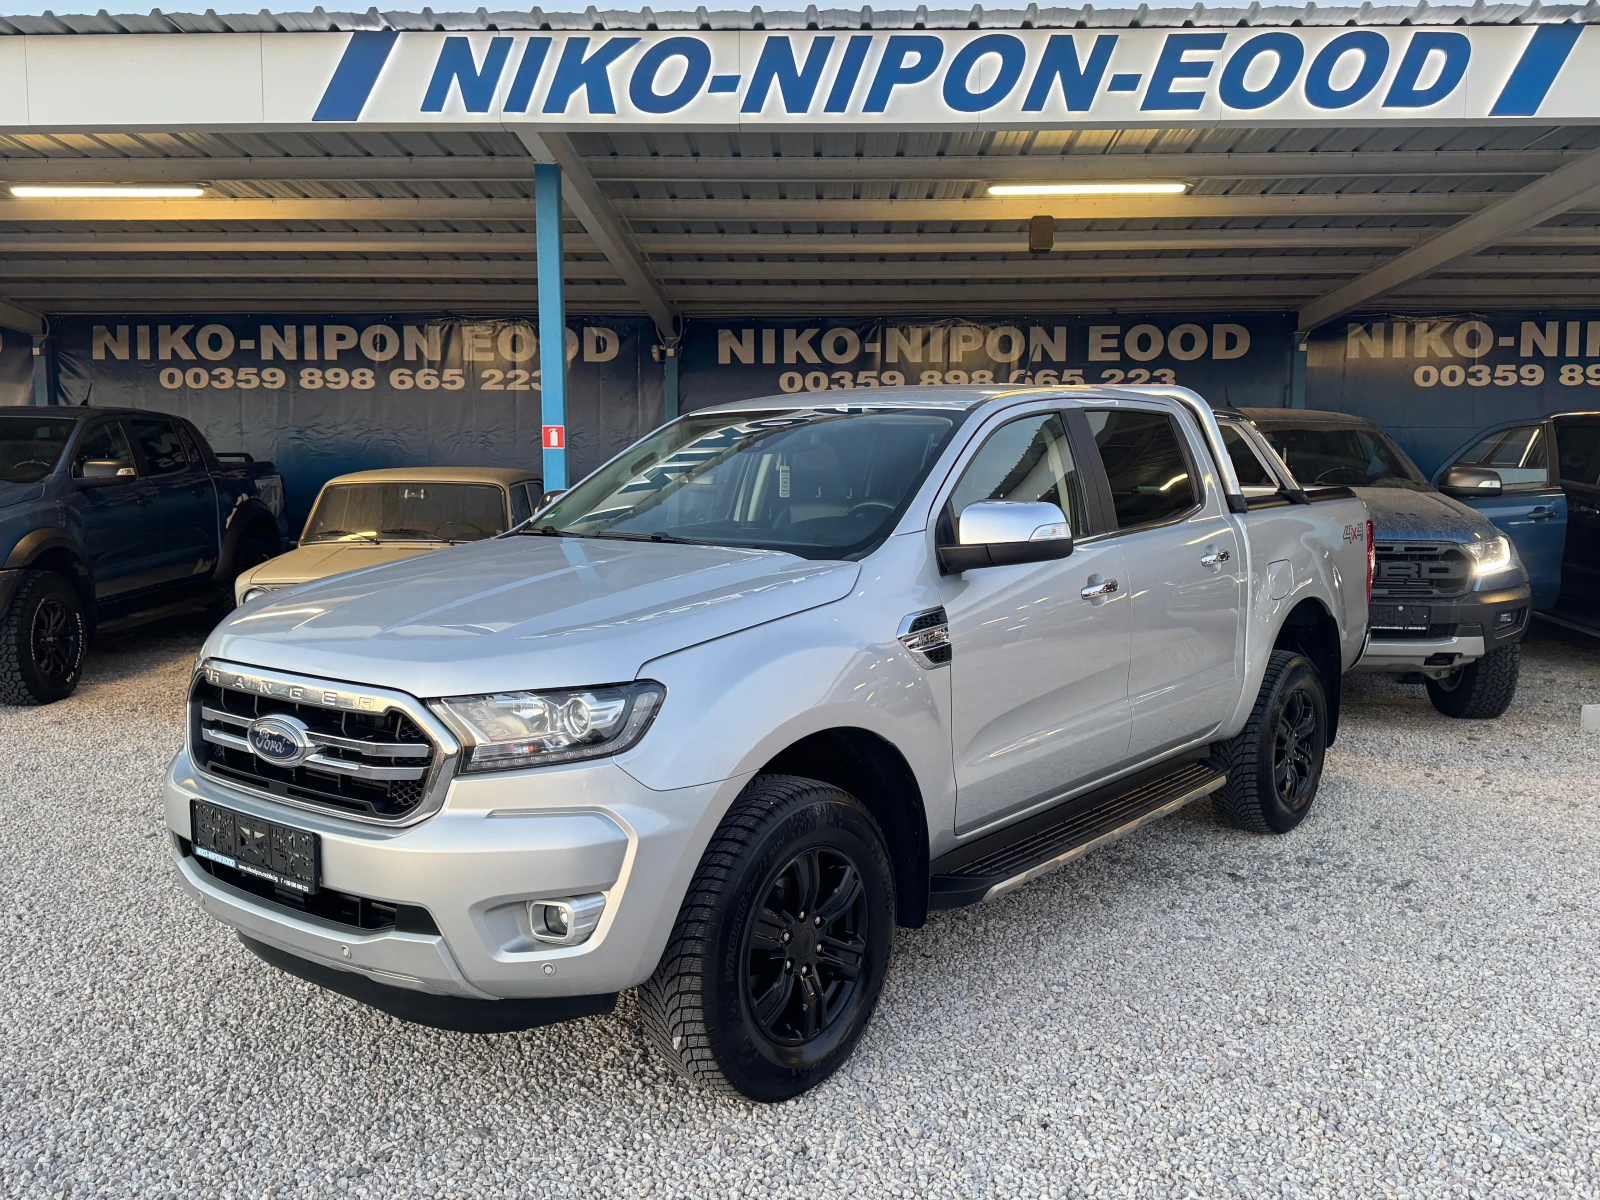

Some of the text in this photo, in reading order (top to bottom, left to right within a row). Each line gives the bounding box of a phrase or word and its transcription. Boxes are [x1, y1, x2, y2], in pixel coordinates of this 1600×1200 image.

[420, 30, 1471, 114] NIKO-NIPON-EOOD
[92, 323, 442, 362] NIKO-NIPON
[718, 323, 1251, 364] NIKO-NIPON EOOD
[159, 367, 286, 390] 00359
[299, 367, 375, 390] 898
[389, 367, 465, 391] 665
[779, 370, 905, 393] 00359
[1414, 364, 1545, 388] 00359
[207, 669, 374, 709] RANGER
[256, 727, 287, 754] Ford
